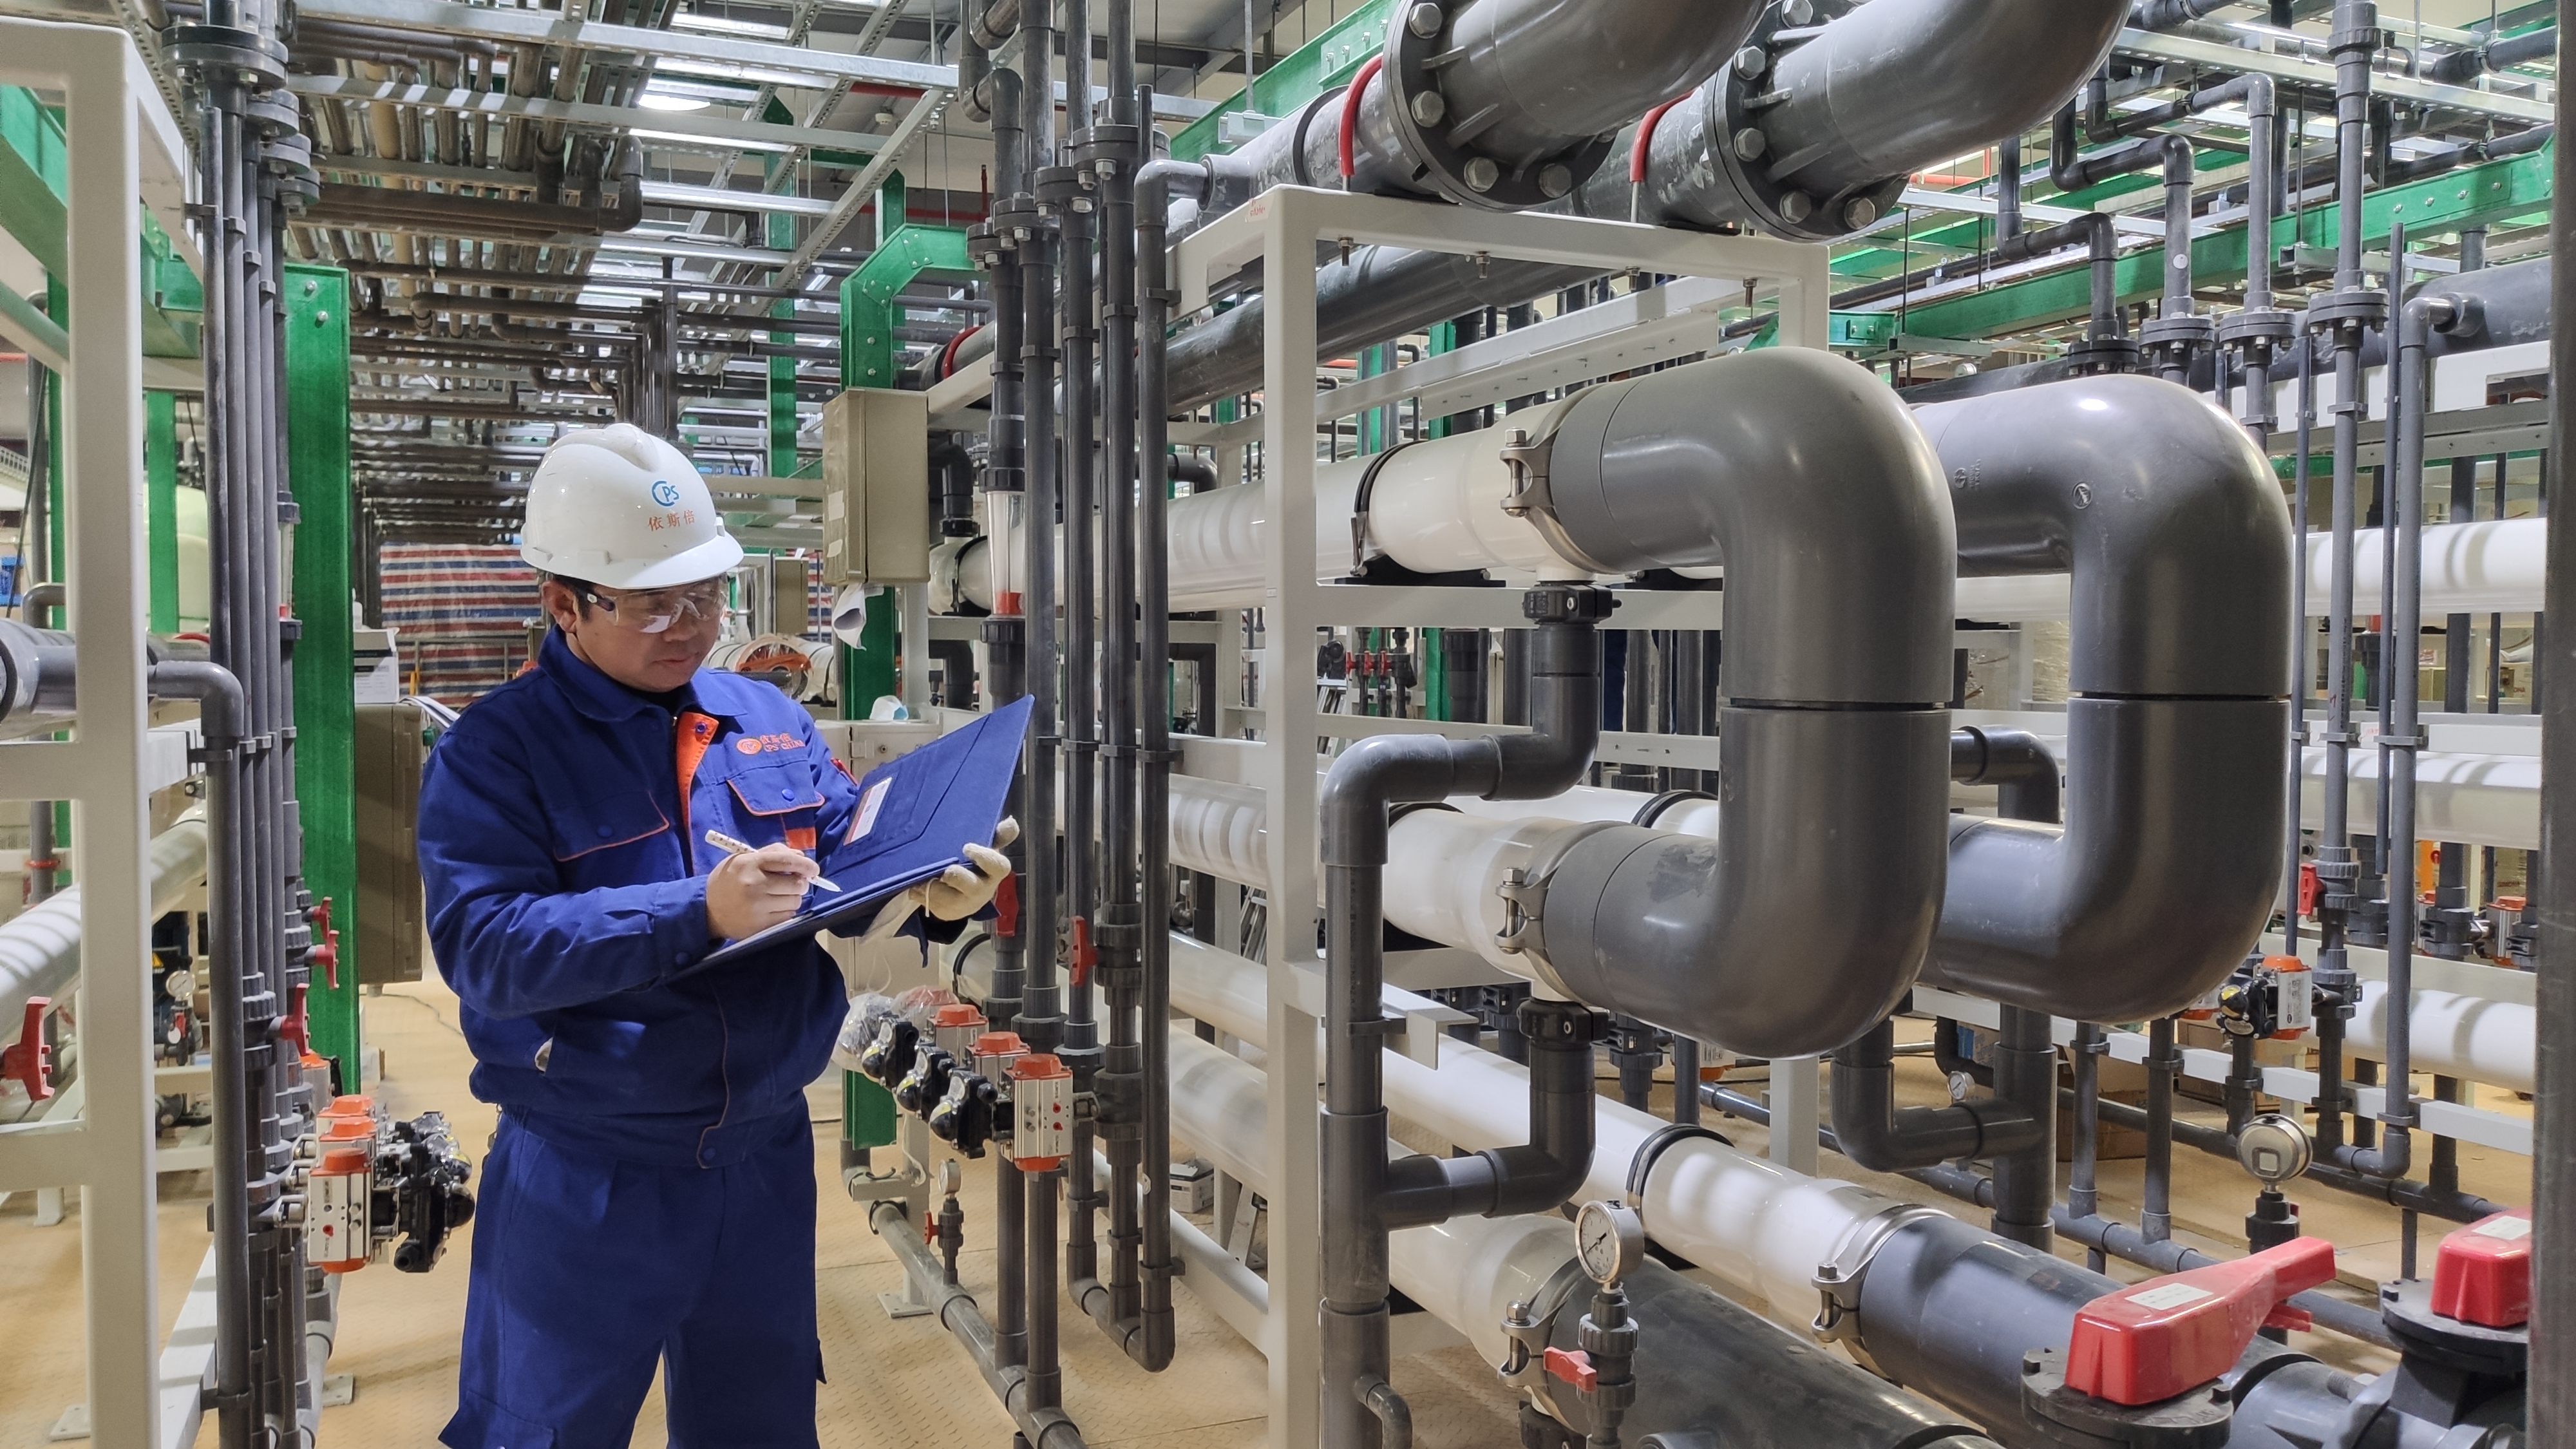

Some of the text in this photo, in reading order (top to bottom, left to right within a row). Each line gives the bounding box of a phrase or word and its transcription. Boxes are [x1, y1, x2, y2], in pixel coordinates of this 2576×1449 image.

[652, 480, 679, 506] CPS
[648, 510, 695, 531] 依斯倍
